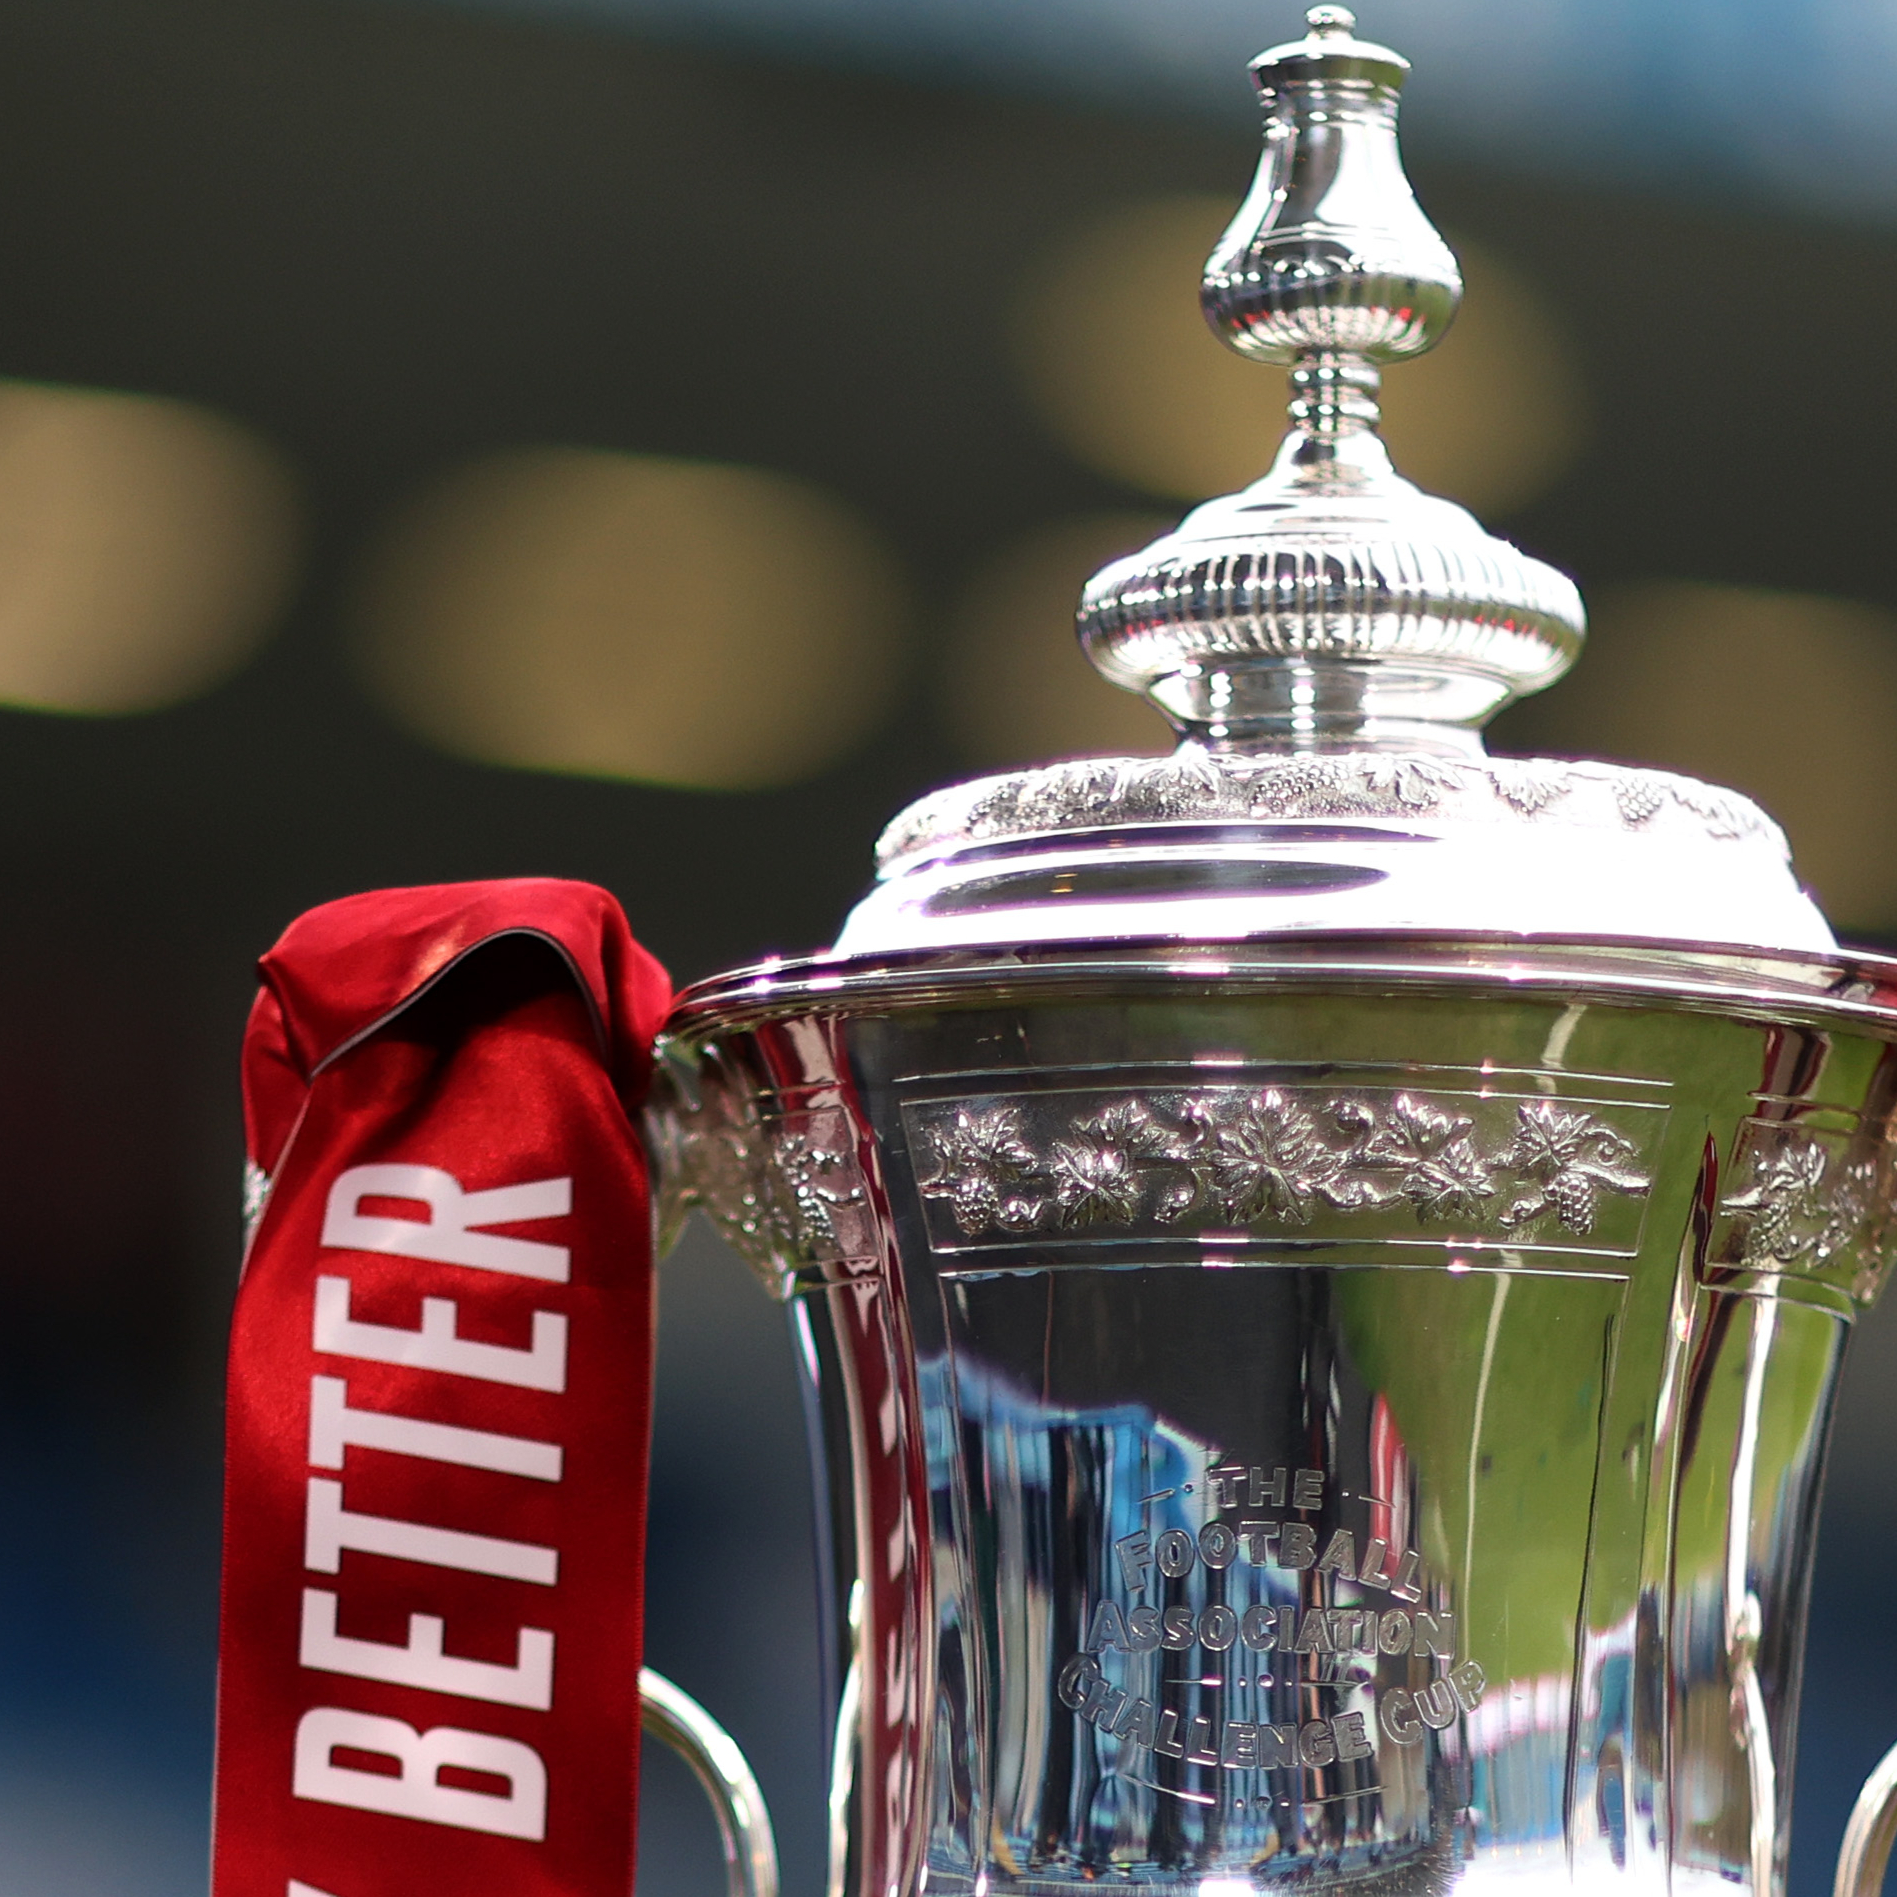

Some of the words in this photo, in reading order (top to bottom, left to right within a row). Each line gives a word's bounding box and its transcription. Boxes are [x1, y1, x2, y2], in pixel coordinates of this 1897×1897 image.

[290, 1161, 574, 1843] BETTER
[1207, 1466, 1326, 1510] THE
[1114, 1520, 1422, 1604] FOOTBALL
[1085, 1600, 1456, 1660] ASSOCIATION
[1057, 1652, 1375, 1770] CHALLENGE
[1379, 1659, 1488, 1746] CUP
